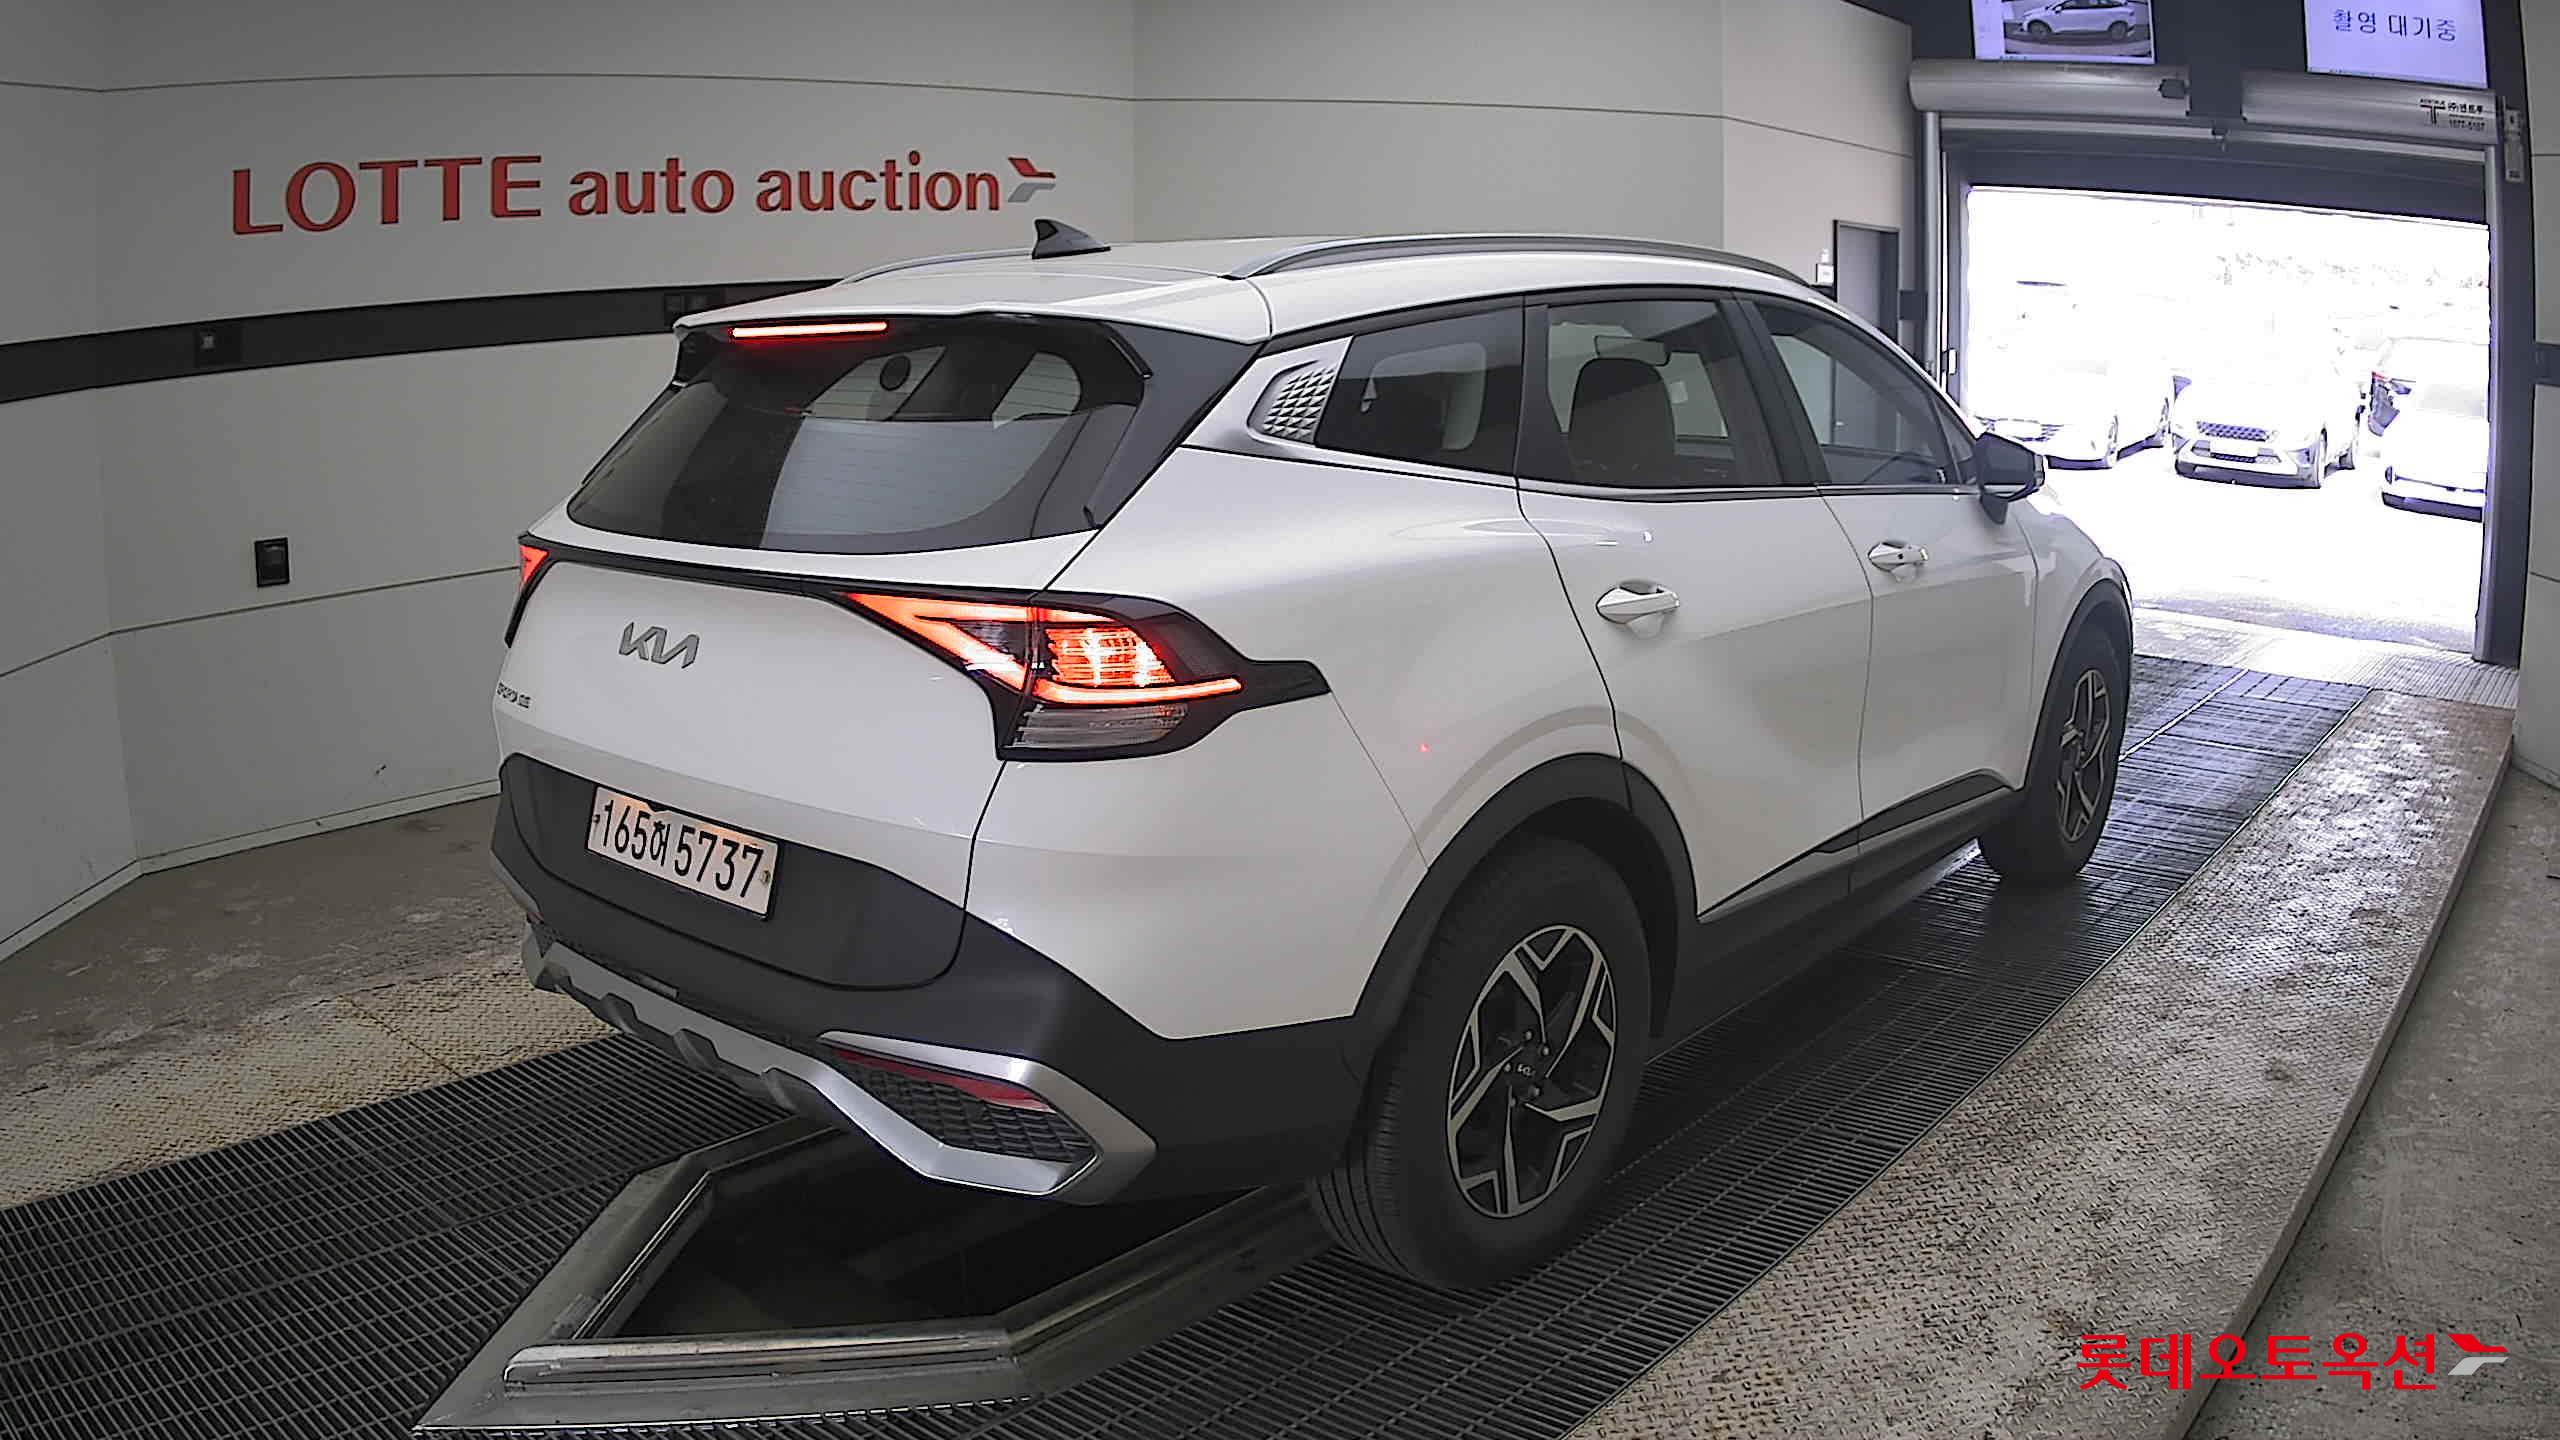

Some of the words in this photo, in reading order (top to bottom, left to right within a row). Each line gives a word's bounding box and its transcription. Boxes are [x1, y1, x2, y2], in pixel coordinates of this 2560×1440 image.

[2333, 9, 2377, 34] 촬영
[2388, 14, 2456, 42] 대기중
[232, 155, 542, 236] LOTTE
[568, 157, 735, 216] auto
[755, 150, 1001, 213] auction
[674, 824, 764, 898] 5737
